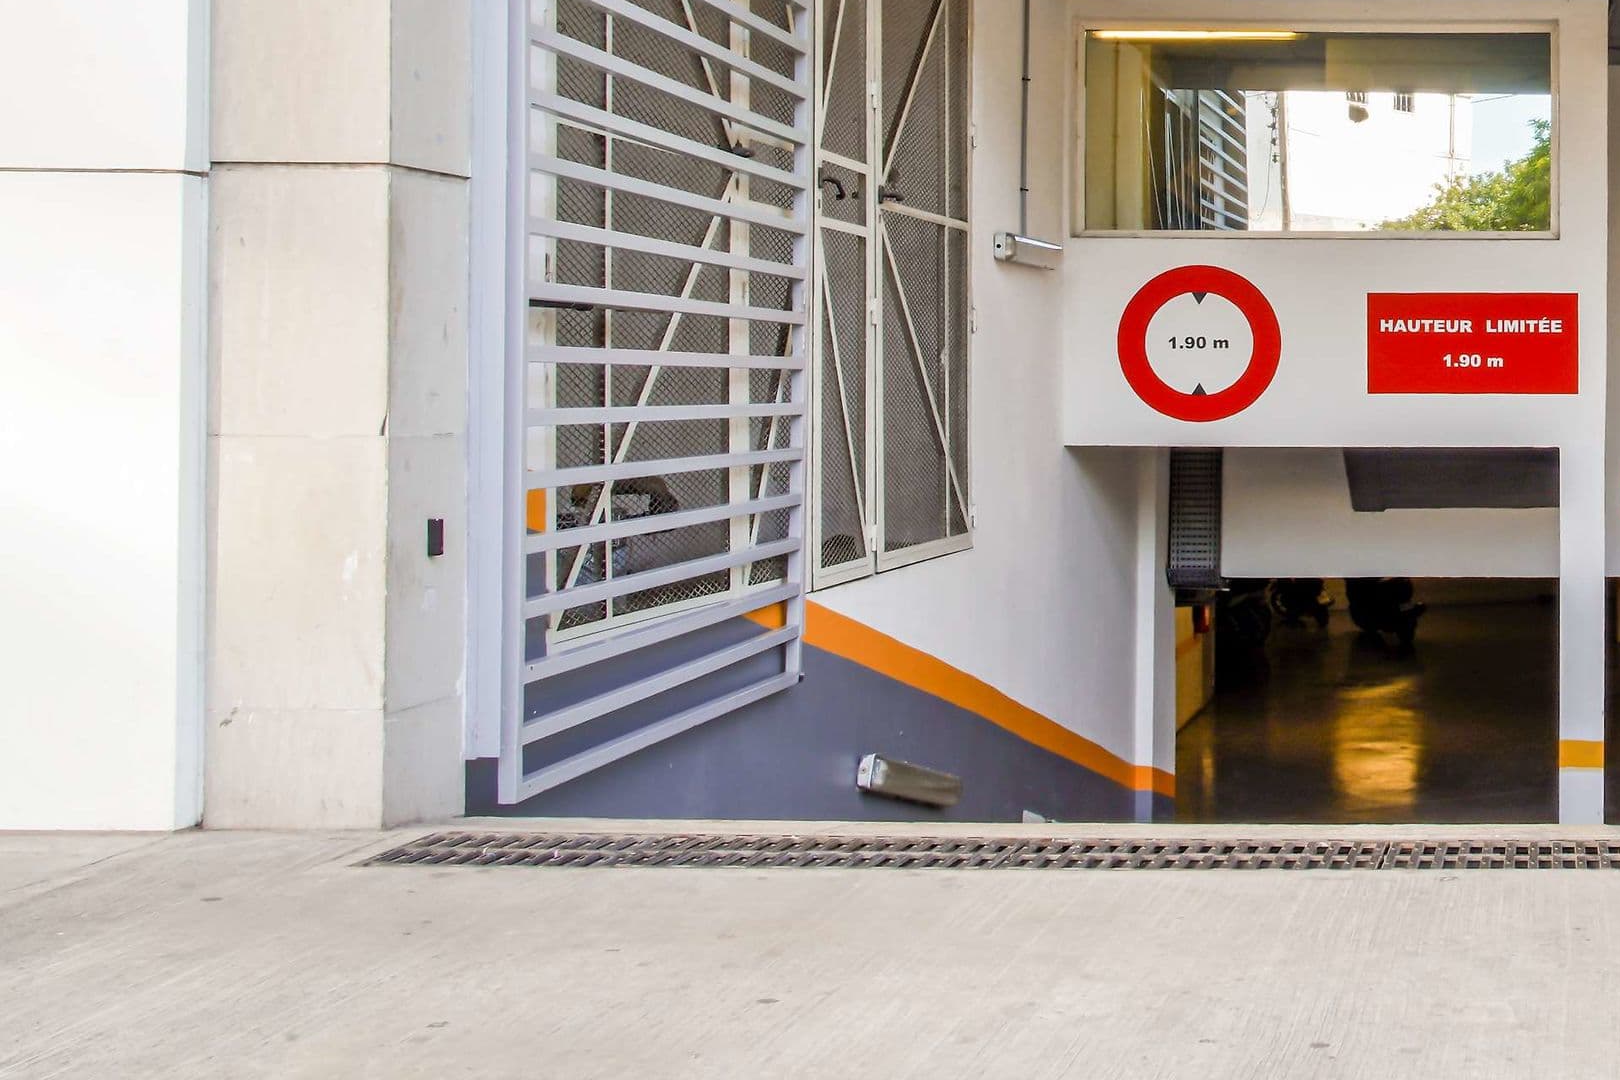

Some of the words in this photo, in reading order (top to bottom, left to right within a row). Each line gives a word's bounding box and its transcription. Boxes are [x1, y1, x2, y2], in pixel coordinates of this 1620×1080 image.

[1379, 319, 1473, 333] HAUTEUR
[1485, 316, 1563, 333] LIMITÉE
[1167, 336, 1207, 350] 1.90
[1212, 338, 1229, 350] m
[1442, 354, 1482, 368] 1.90
[1486, 357, 1504, 368] m
